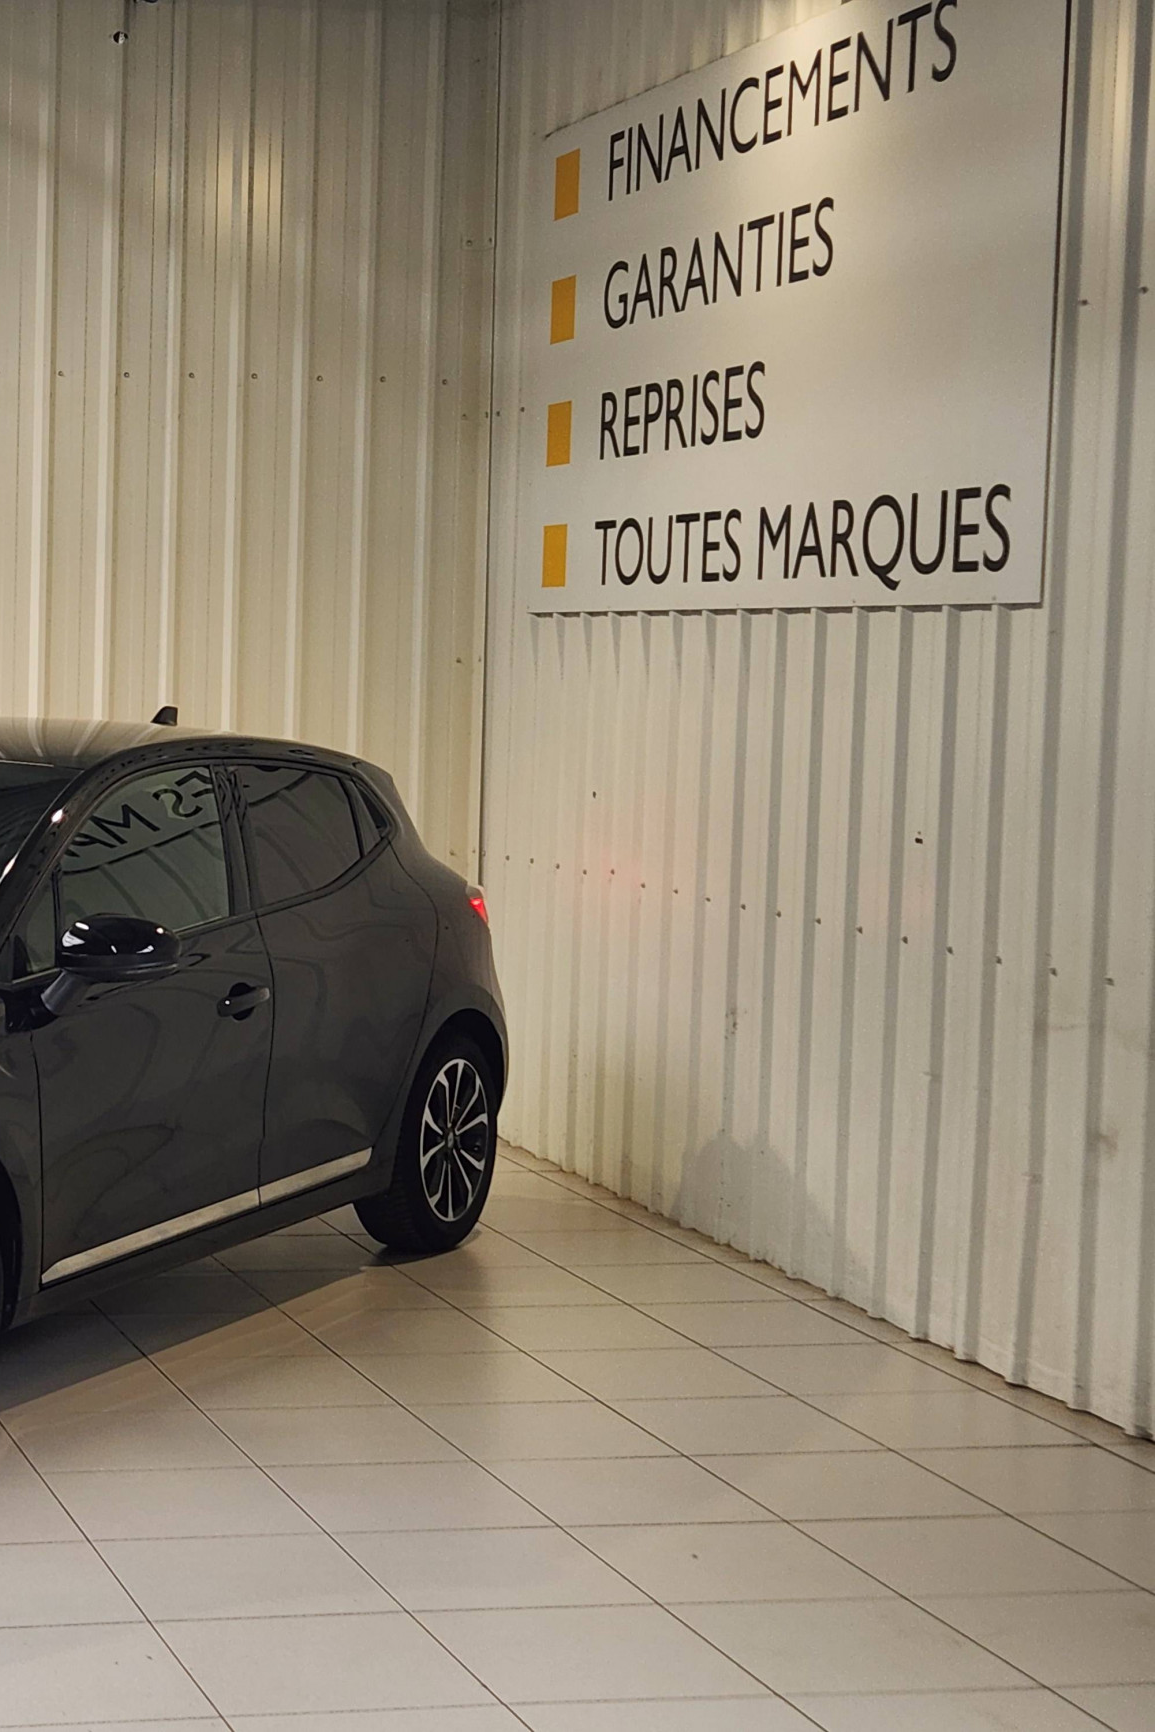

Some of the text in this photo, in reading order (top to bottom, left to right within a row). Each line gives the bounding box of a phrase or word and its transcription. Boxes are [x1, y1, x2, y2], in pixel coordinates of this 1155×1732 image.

[607, 0, 958, 201] FINANCEMENTS
[603, 197, 835, 329] GARANTIES
[599, 361, 766, 460] REPRISES
[595, 484, 1012, 591] TOUTES MARQUES
